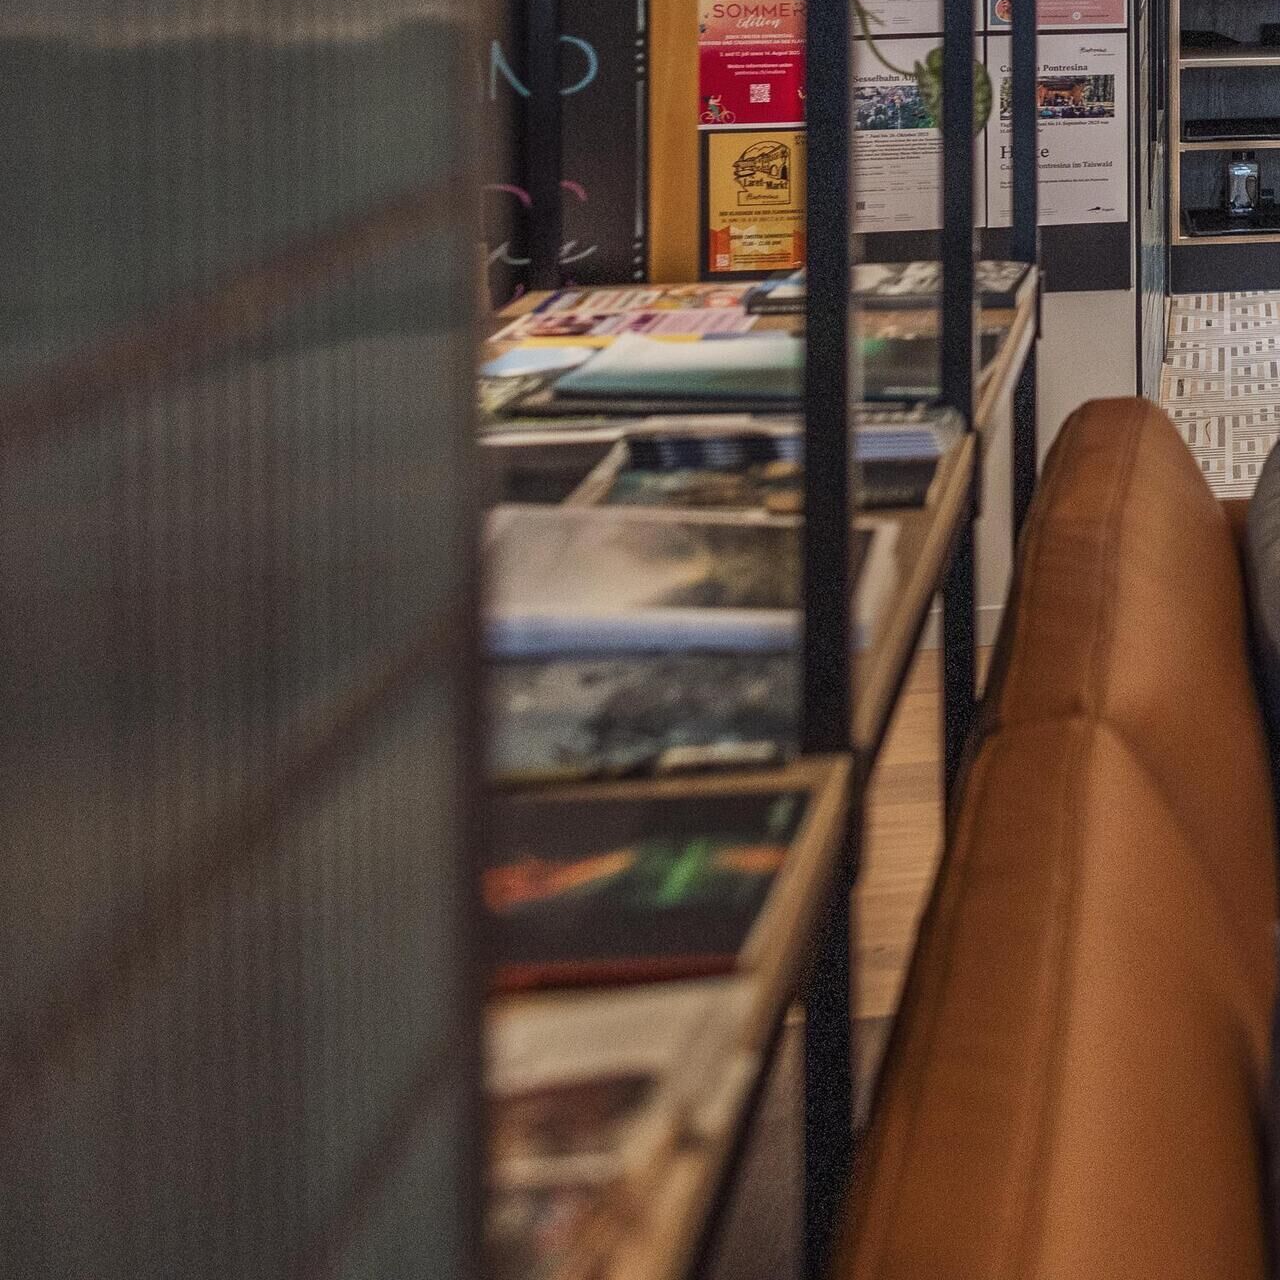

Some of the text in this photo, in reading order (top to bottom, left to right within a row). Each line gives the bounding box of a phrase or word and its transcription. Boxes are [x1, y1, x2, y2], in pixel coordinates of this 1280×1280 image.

[712, 2, 807, 18] SOMMER
[1043, 64, 1088, 72] Pontresina
[854, 74, 900, 83] Sesselbahn
[1000, 144, 1050, 159] Hte
[744, 178, 788, 190] Laret-Markt
